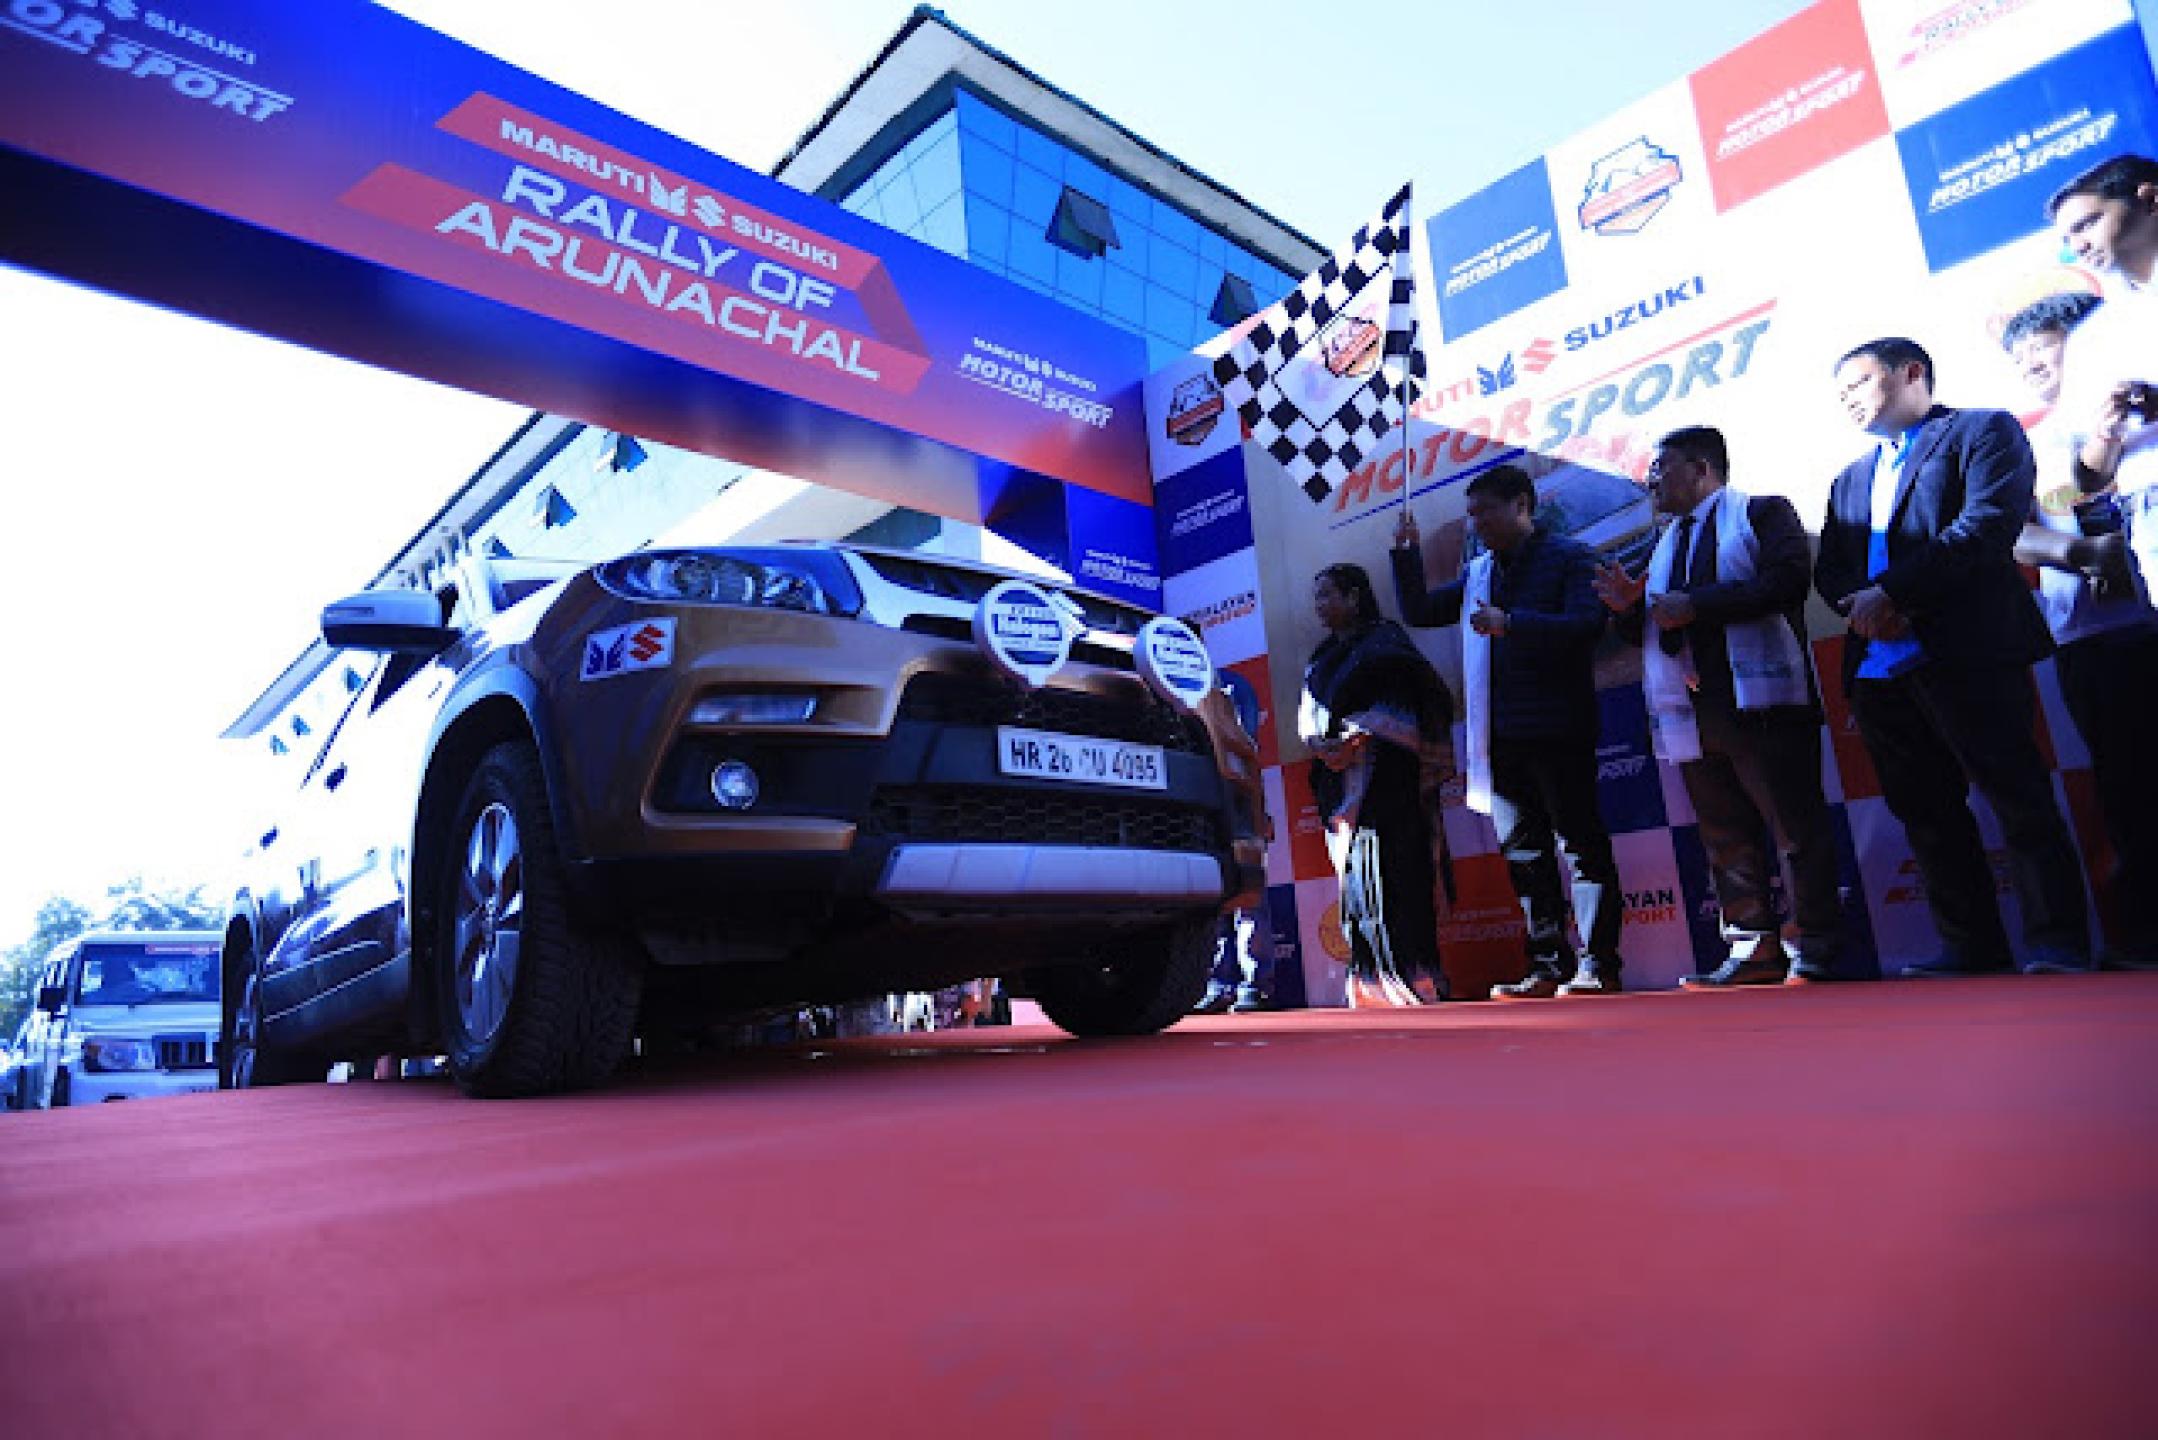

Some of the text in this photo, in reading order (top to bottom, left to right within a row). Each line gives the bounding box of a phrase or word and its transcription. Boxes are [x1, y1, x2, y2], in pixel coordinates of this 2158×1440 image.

[145, 11, 256, 65] SUZUKI
[97, 43, 290, 122] SPORT
[2022, 112, 2119, 174] SPORT
[501, 119, 838, 271] MARUTI SUZUKI
[502, 164, 838, 310] RALLY OF
[434, 201, 881, 382] ARUNACHAL
[1564, 275, 1705, 352] SUZUKI
[960, 353, 1114, 429] MOTOR SPORT
[1334, 318, 1771, 513] MOTOR SPORT
[1010, 737, 1043, 770] HR
